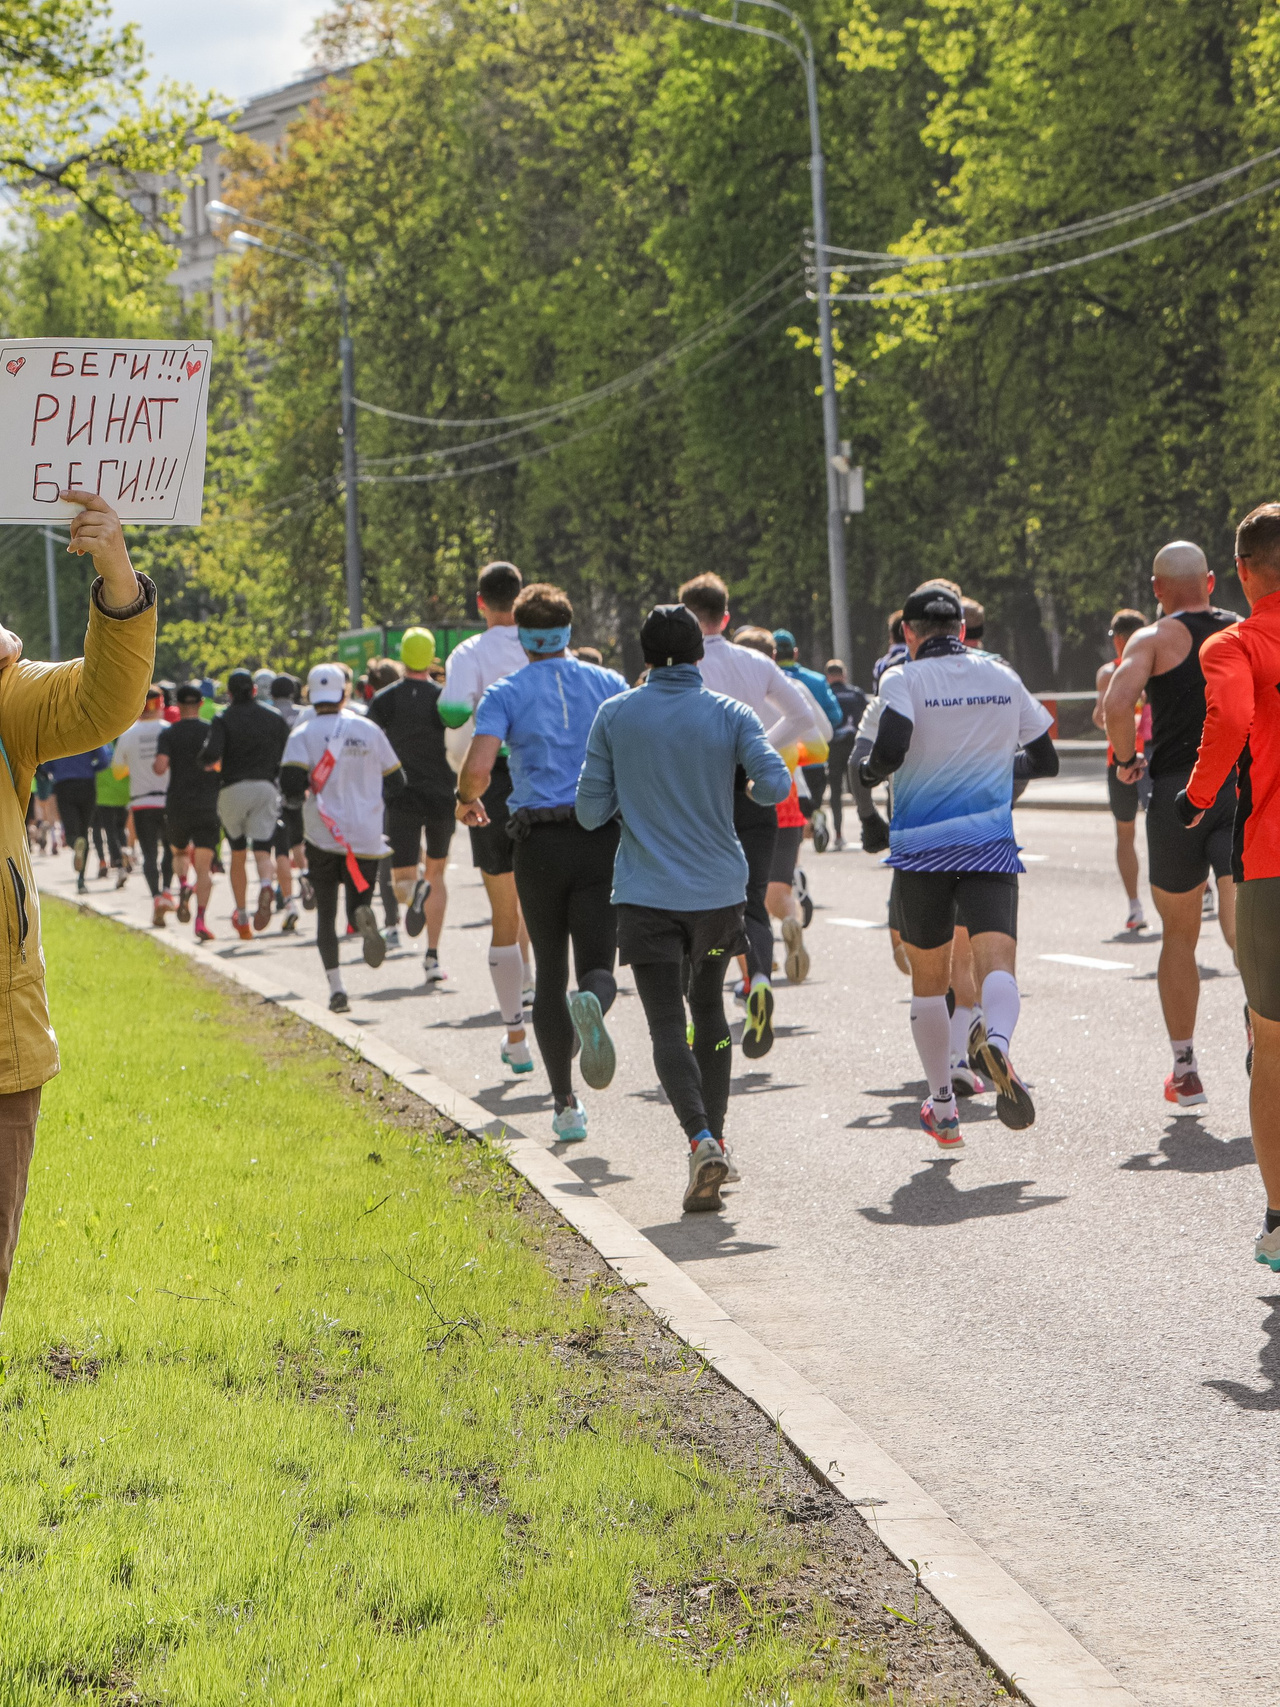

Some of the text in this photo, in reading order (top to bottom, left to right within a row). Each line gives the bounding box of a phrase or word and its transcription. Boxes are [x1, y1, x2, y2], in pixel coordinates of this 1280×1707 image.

[50, 350, 188, 382] БЕГИ!!!
[31, 393, 179, 446] РИНАТ
[925, 696, 1011, 707] НА ШАГ ВПЕРЕДИ
